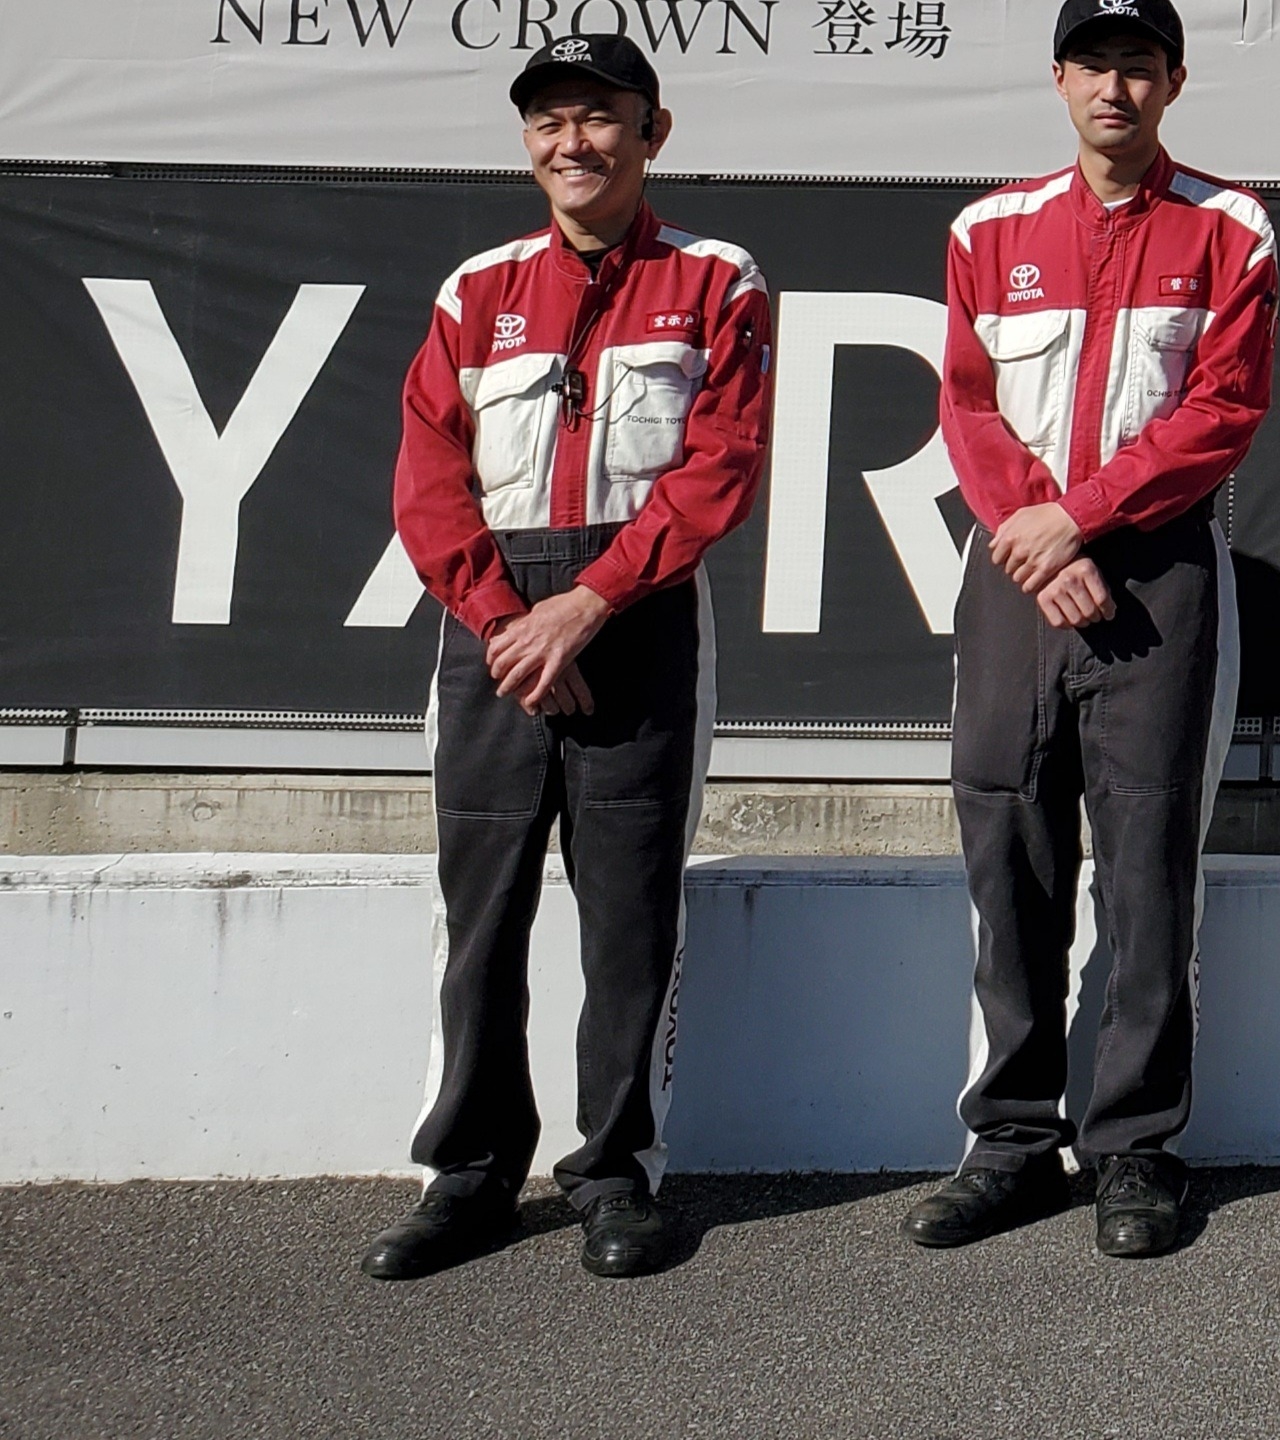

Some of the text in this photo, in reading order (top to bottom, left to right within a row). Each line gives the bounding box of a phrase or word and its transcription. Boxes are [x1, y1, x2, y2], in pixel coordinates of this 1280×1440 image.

[1093, 6, 1140, 18] YOTA
[553, 53, 593, 63] YOTA
[1007, 287, 1045, 303] TOYOTA
[491, 334, 527, 354] OYOTA
[627, 415, 663, 425] TOCHIGI
